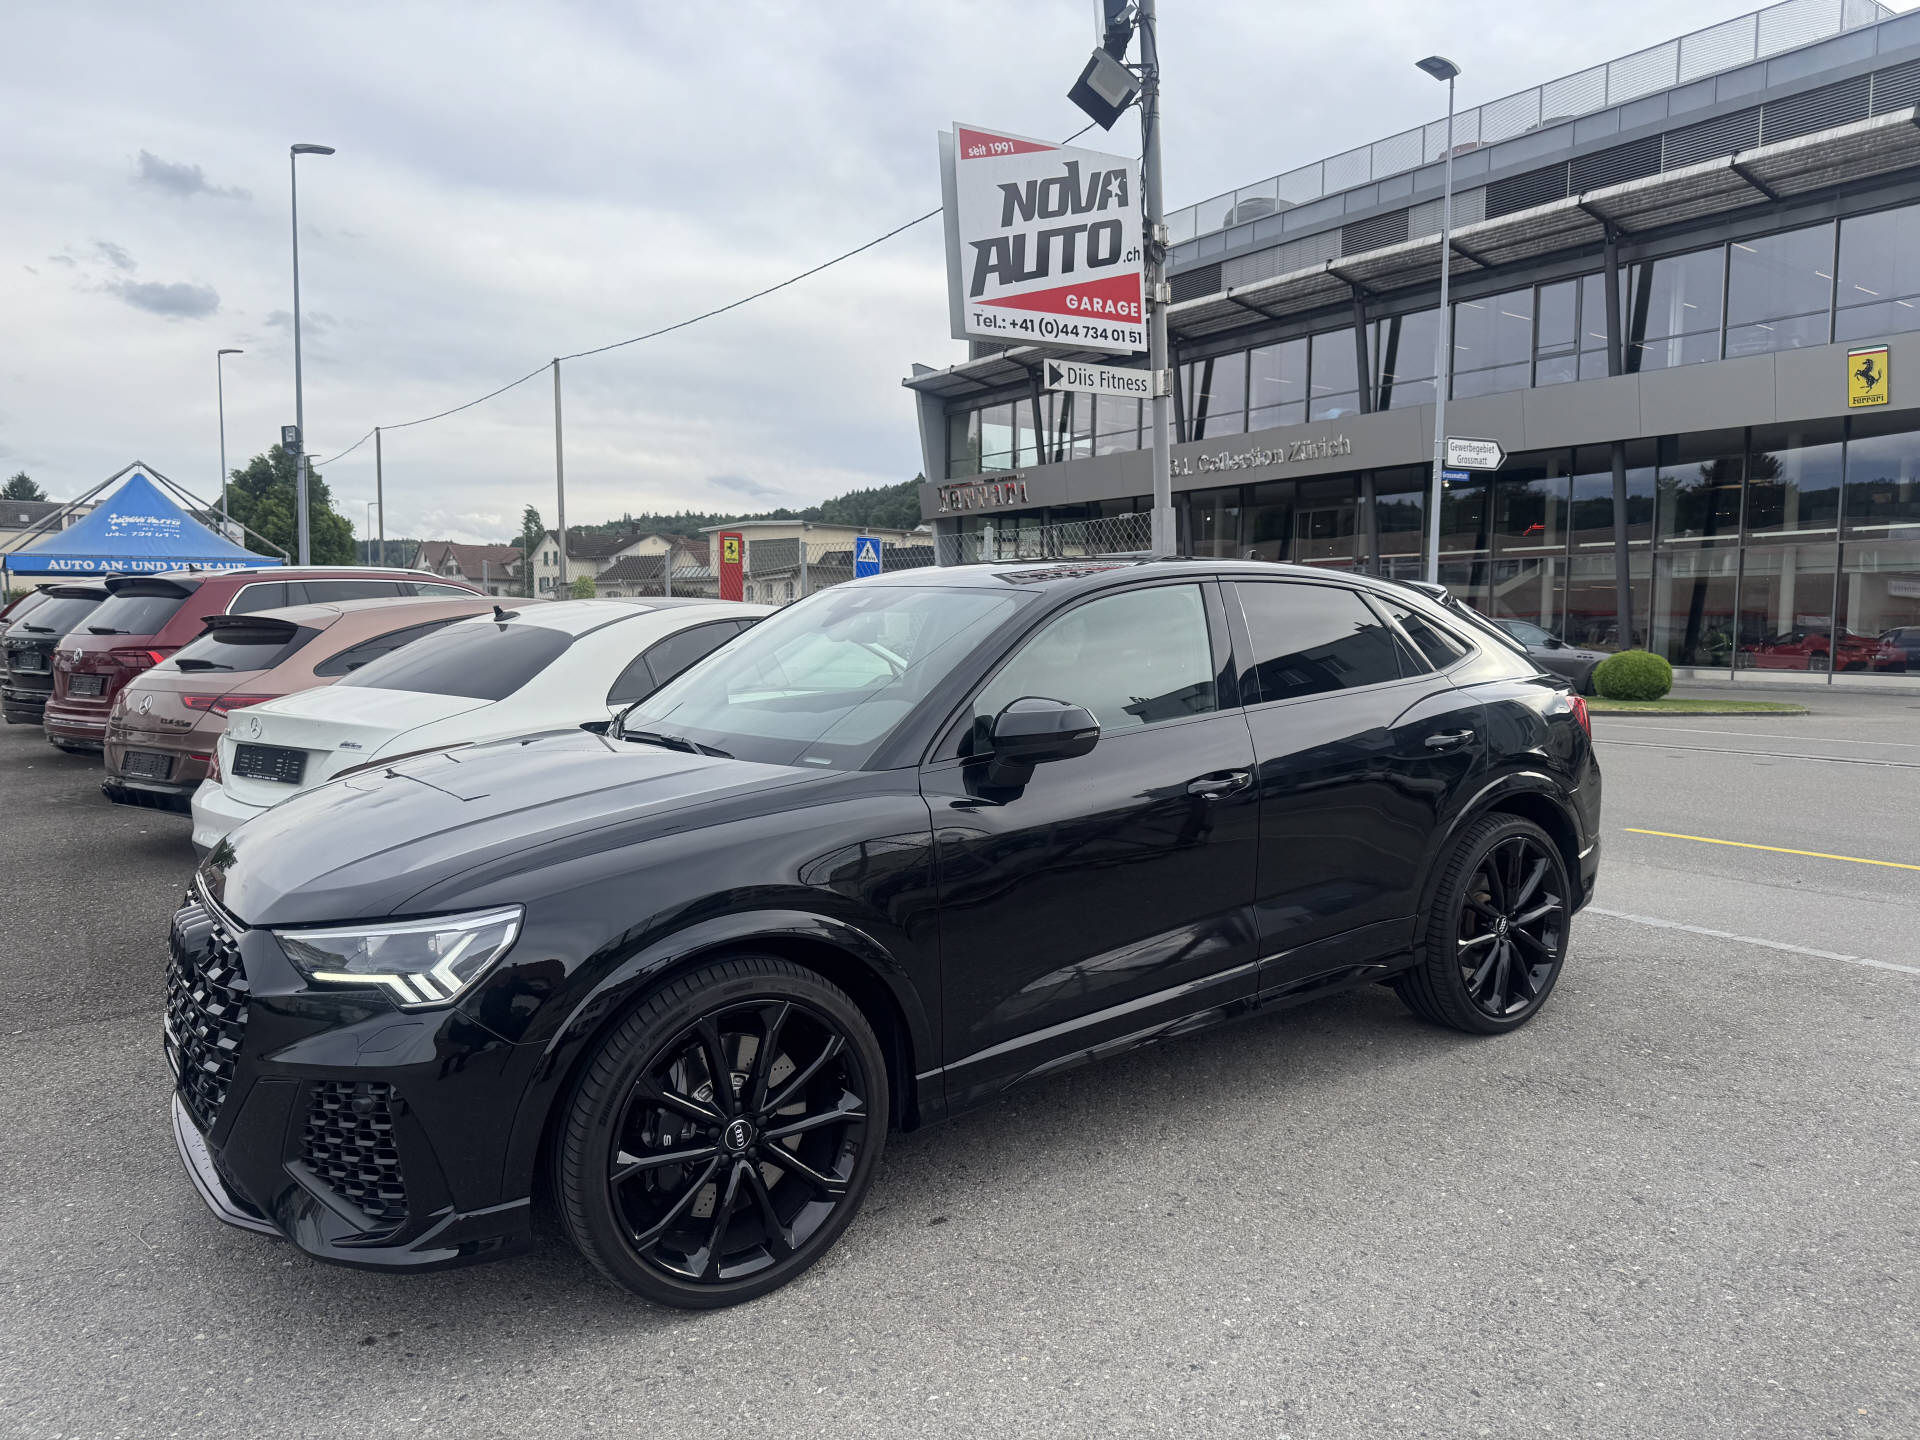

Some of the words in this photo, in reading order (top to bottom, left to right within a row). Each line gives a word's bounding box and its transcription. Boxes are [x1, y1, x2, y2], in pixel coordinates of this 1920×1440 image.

[968, 143, 986, 157] seit
[989, 141, 1015, 154] 1991
[996, 160, 1129, 227] NOVA
[1065, 294, 1139, 317] GARAGE
[973, 313, 1007, 330] Tel.:
[1009, 318, 1035, 333] +41
[1082, 325, 1109, 341] 734
[1067, 366, 1095, 387] Diis
[1099, 370, 1148, 392] Fitness
[1852, 393, 1884, 405] Ferrari
[1197, 446, 1285, 473] Collection
[1288, 433, 1351, 463] Zürich
[1450, 441, 1495, 455] Gewerbegebiet
[1457, 454, 1488, 465] Grossmatt
[48, 559, 95, 571] AUTO
[99, 560, 128, 571] AN-
[132, 560, 168, 571] UND
